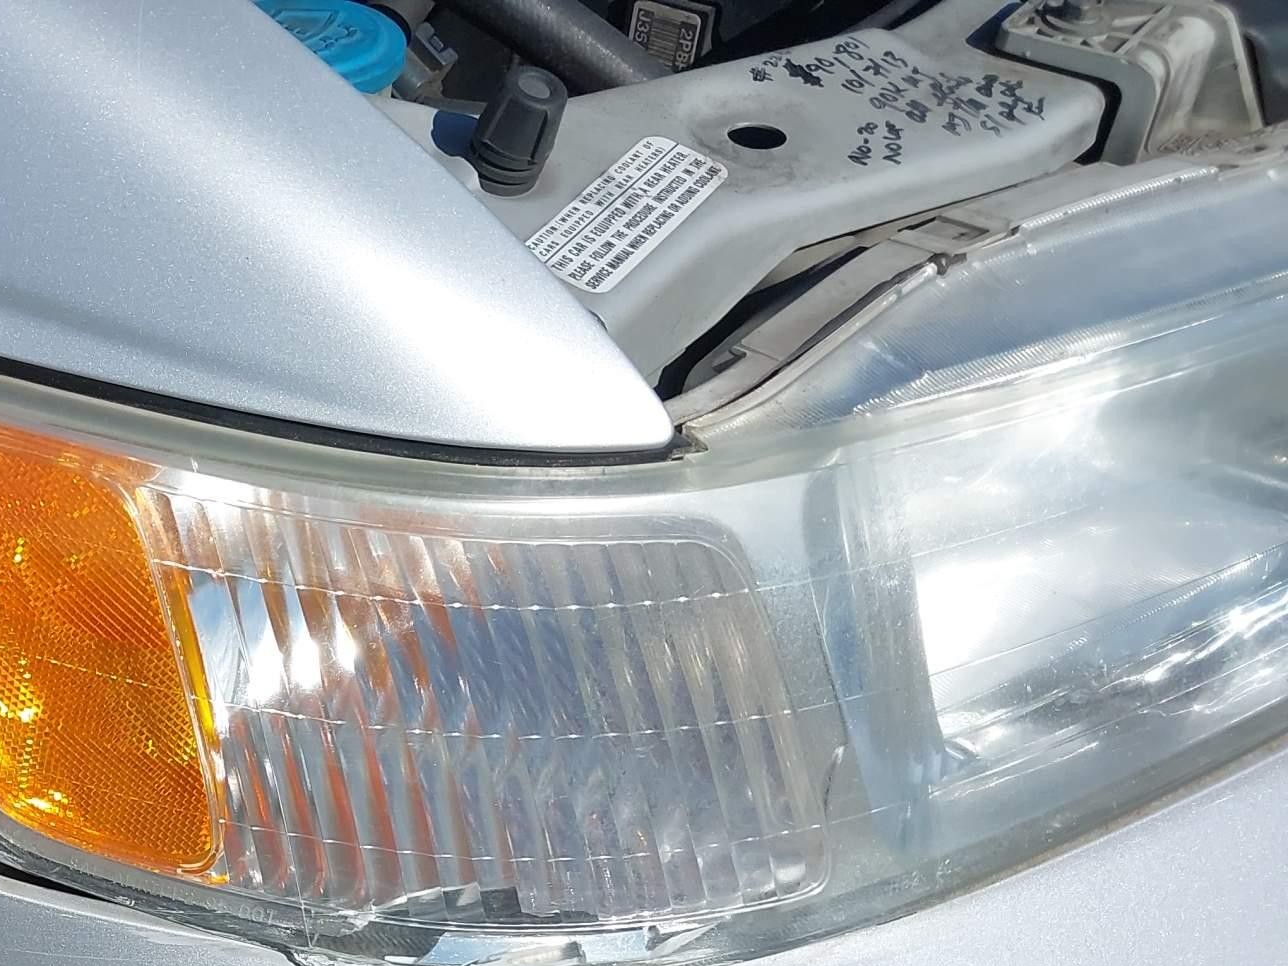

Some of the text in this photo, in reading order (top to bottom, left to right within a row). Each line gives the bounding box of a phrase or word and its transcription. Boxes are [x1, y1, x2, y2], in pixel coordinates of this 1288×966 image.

[539, 241, 560, 257] CARS
[560, 210, 593, 238] EQUIPPED
[594, 190, 615, 207] WITH
[614, 174, 634, 190] REAR
[550, 254, 574, 271] THIS
[568, 242, 589, 257] CAR
[581, 234, 596, 245] IS
[590, 207, 626, 237] EQUIPPED
[620, 191, 643, 209] WITH
[643, 172, 666, 189] REAR
[568, 157, 707, 281] PLEASE FOLLOW THE PROCEDURE INSTRUCTED IN THE
[579, 175, 616, 204] REPLACING
[614, 150, 644, 175] COOLANT
[642, 140, 654, 150] OF
[584, 266, 613, 289] SERVICE
[605, 245, 634, 271] MANUAL
[628, 232, 649, 252] WHEN
[641, 209, 675, 237] REPLACING
[667, 203, 683, 213] OR
[675, 186, 700, 206] ADDING
